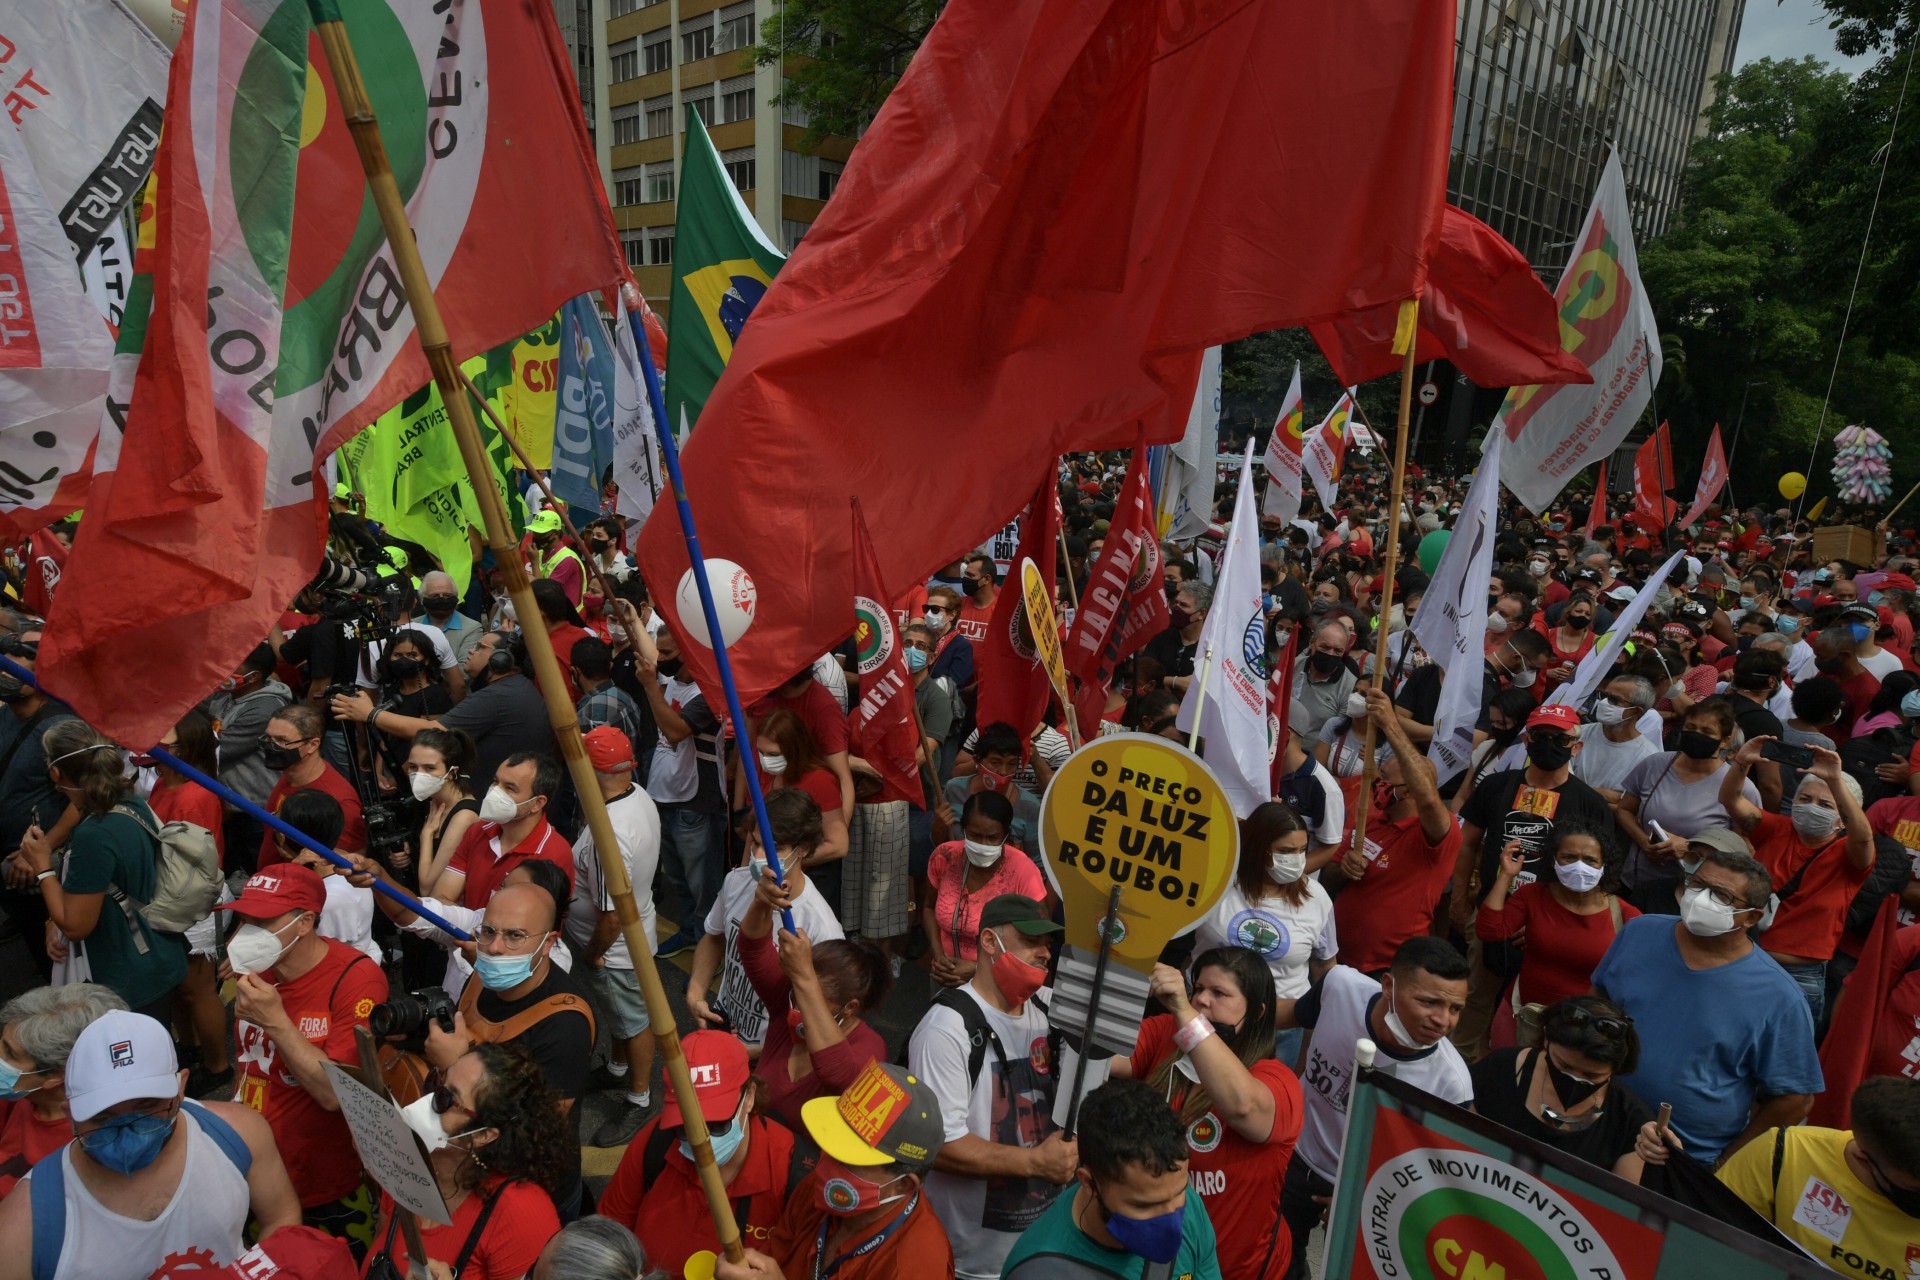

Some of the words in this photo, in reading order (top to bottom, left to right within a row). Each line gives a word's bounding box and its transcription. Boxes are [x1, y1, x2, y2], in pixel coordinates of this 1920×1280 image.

[1080, 528, 1142, 656] VACINA
[1121, 598, 1158, 640] MENT
[863, 645, 891, 671] BRASIL
[1240, 667, 1256, 685] Brasil
[1239, 676, 1264, 707] ENERGIA
[1091, 760, 1108, 777] O
[1118, 767, 1202, 804] PREÇO
[1082, 781, 1128, 817] DA
[1140, 798, 1211, 841] LUZ
[1118, 825, 1181, 871] UM
[1059, 840, 1199, 907] ROUBO!
[299, 1017, 329, 1032] FORA
[1305, 1057, 1332, 1094] 30
[1313, 1048, 1340, 1077] MAB
[1195, 1127, 1212, 1136] CMP
[1372, 1187, 1397, 1277] CENTRAL
[1392, 1164, 1423, 1189] DE
[1427, 1158, 1595, 1254] MOVIMENTOS
[1830, 1244, 1897, 1280] FORA
